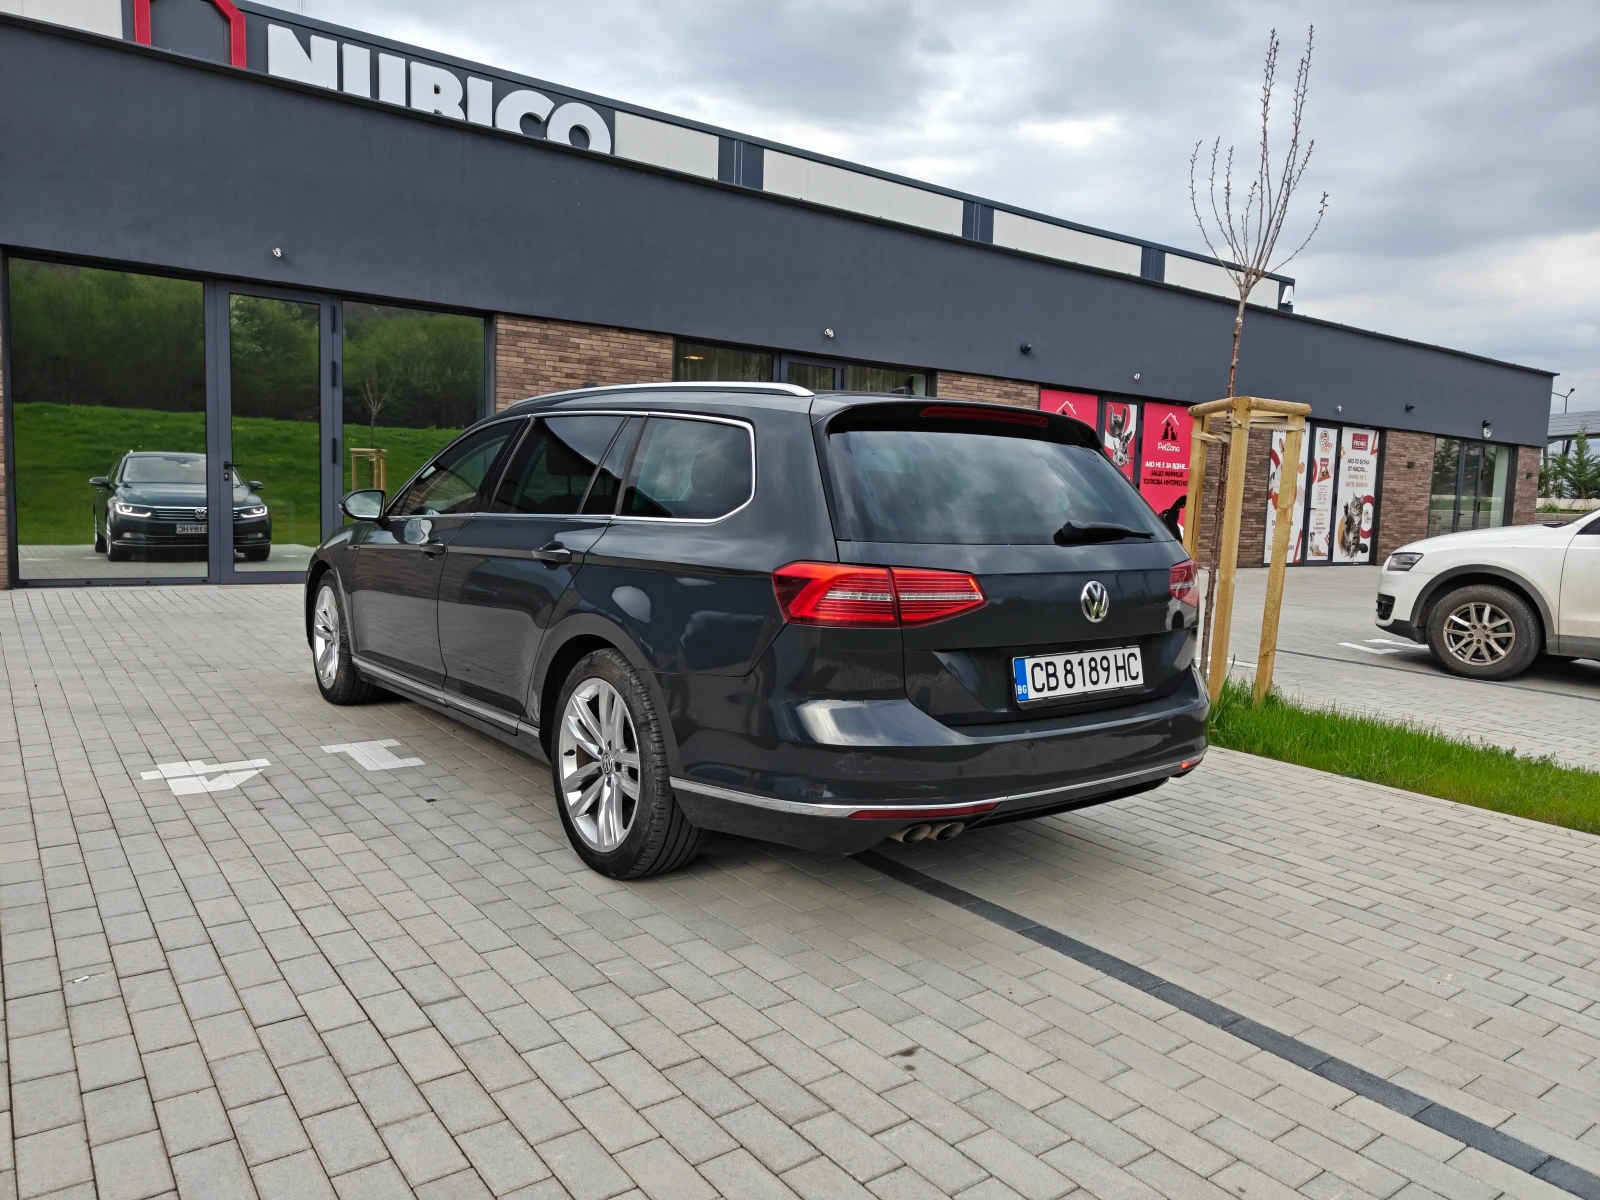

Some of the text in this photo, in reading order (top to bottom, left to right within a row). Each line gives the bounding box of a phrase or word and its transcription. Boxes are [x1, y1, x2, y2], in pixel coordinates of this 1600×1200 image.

[1031, 652, 1140, 693] CB 8189 HC
[1017, 685, 1028, 694] BG
